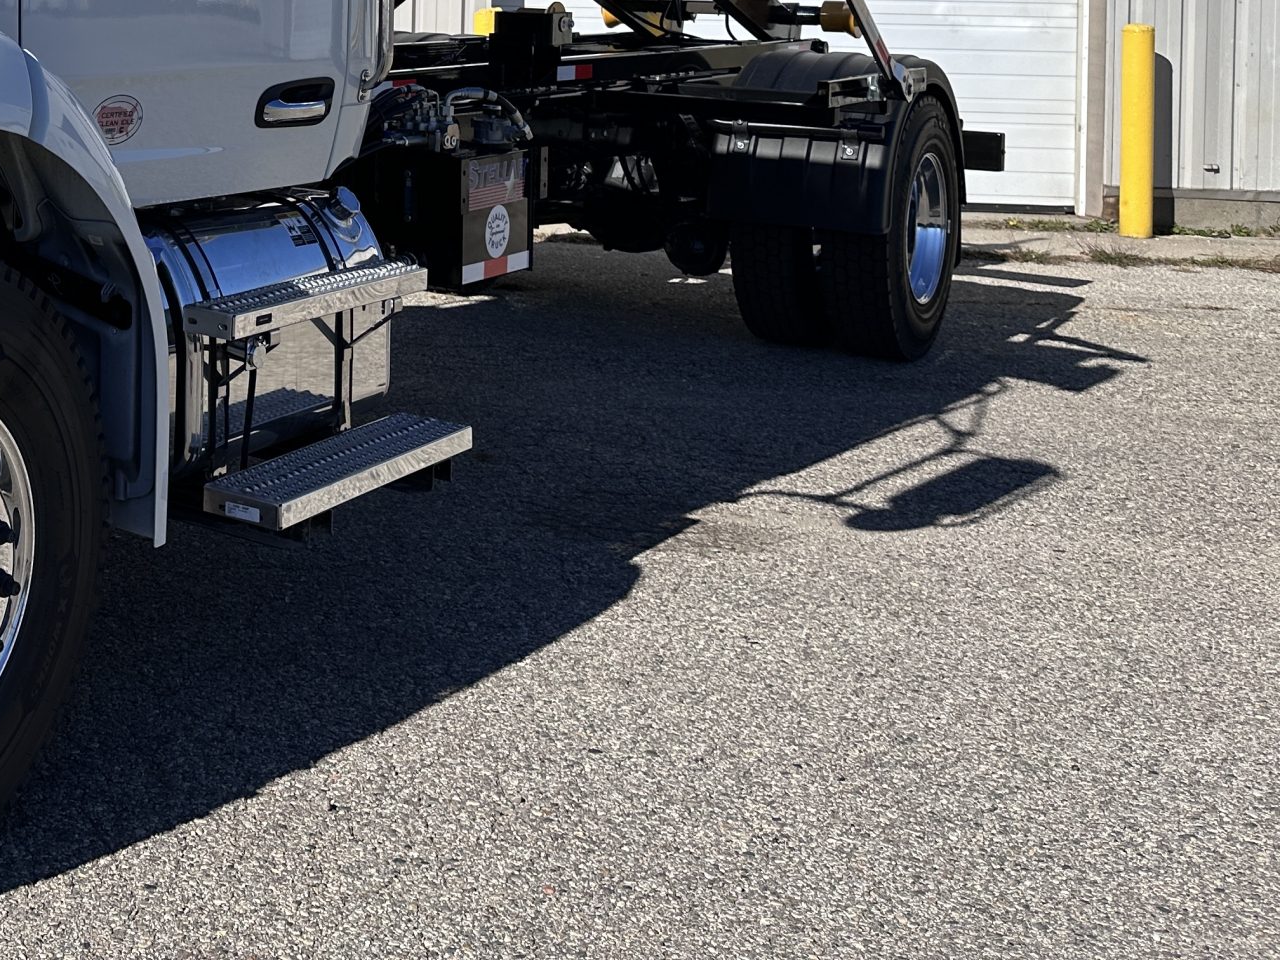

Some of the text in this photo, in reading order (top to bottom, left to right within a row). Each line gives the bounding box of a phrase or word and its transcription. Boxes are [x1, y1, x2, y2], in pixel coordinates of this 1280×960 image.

[101, 111, 133, 119] CERTIFIED
[487, 211, 509, 229] QUALITY
[488, 233, 507, 250] TRUCK
